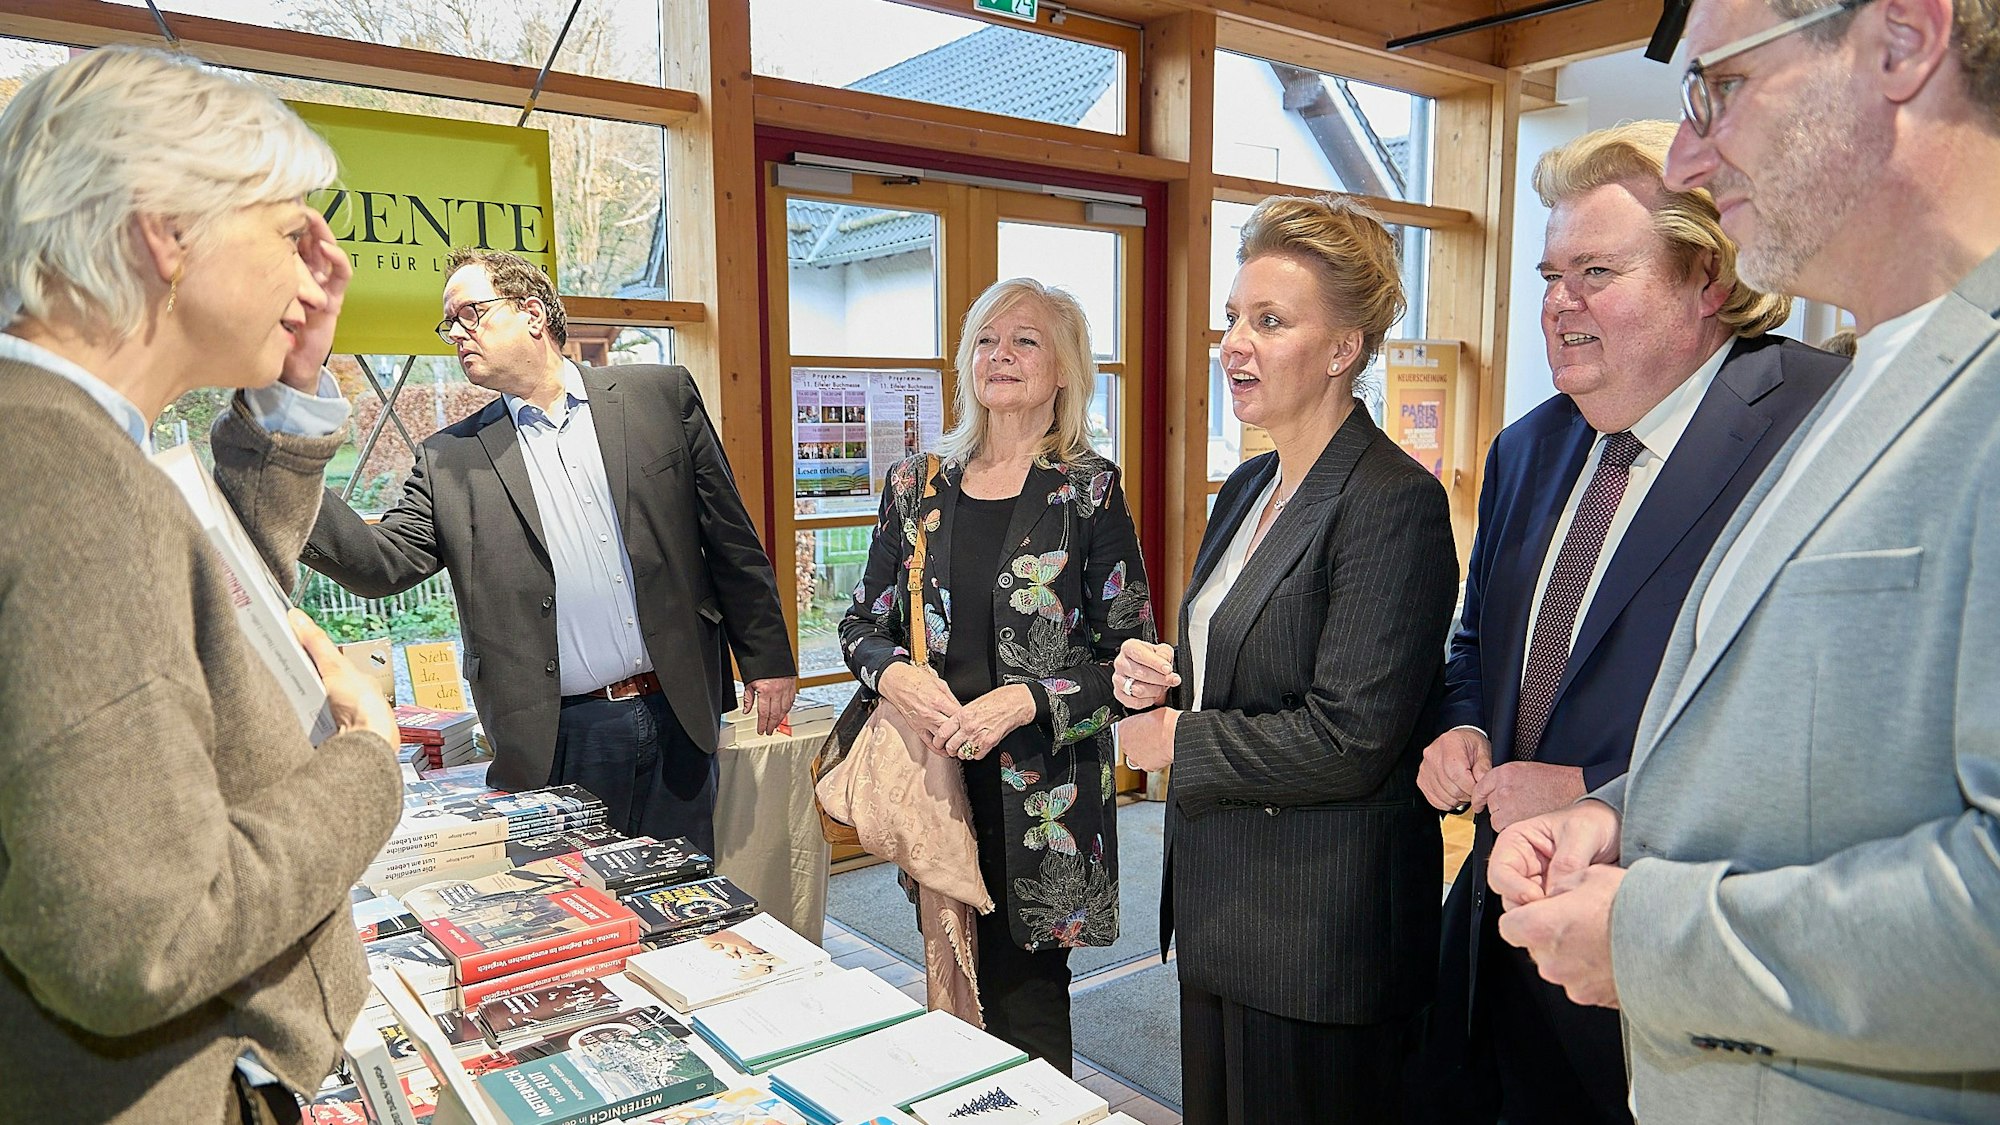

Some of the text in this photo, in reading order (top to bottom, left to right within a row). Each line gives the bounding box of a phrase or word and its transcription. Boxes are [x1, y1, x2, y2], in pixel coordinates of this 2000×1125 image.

[307, 188, 549, 254] ZENTE
[376, 252, 417, 271] FÜR
[812, 373, 847, 383] Programm
[888, 375, 921, 384] Programm
[1397, 373, 1448, 383] NEUERSCHEINUNG
[1401, 404, 1437, 417] PARIS
[797, 466, 847, 475] Lesen erleben.
[419, 650, 448, 664] Sieh
[437, 685, 458, 699] das
[386, 844, 423, 855] unendliche
[385, 868, 421, 880] unendliche
[477, 931, 620, 972] Marchal Die Beginen im europäischen Vergleich
[481, 959, 622, 1002] Marchal Die Beginen im europäischen Vergleich
[505, 1069, 554, 1117] METTERNICH
[527, 1071, 566, 1104] in der FLUT
[589, 1093, 663, 1124] METTERNICH
[578, 1116, 588, 1124] in
